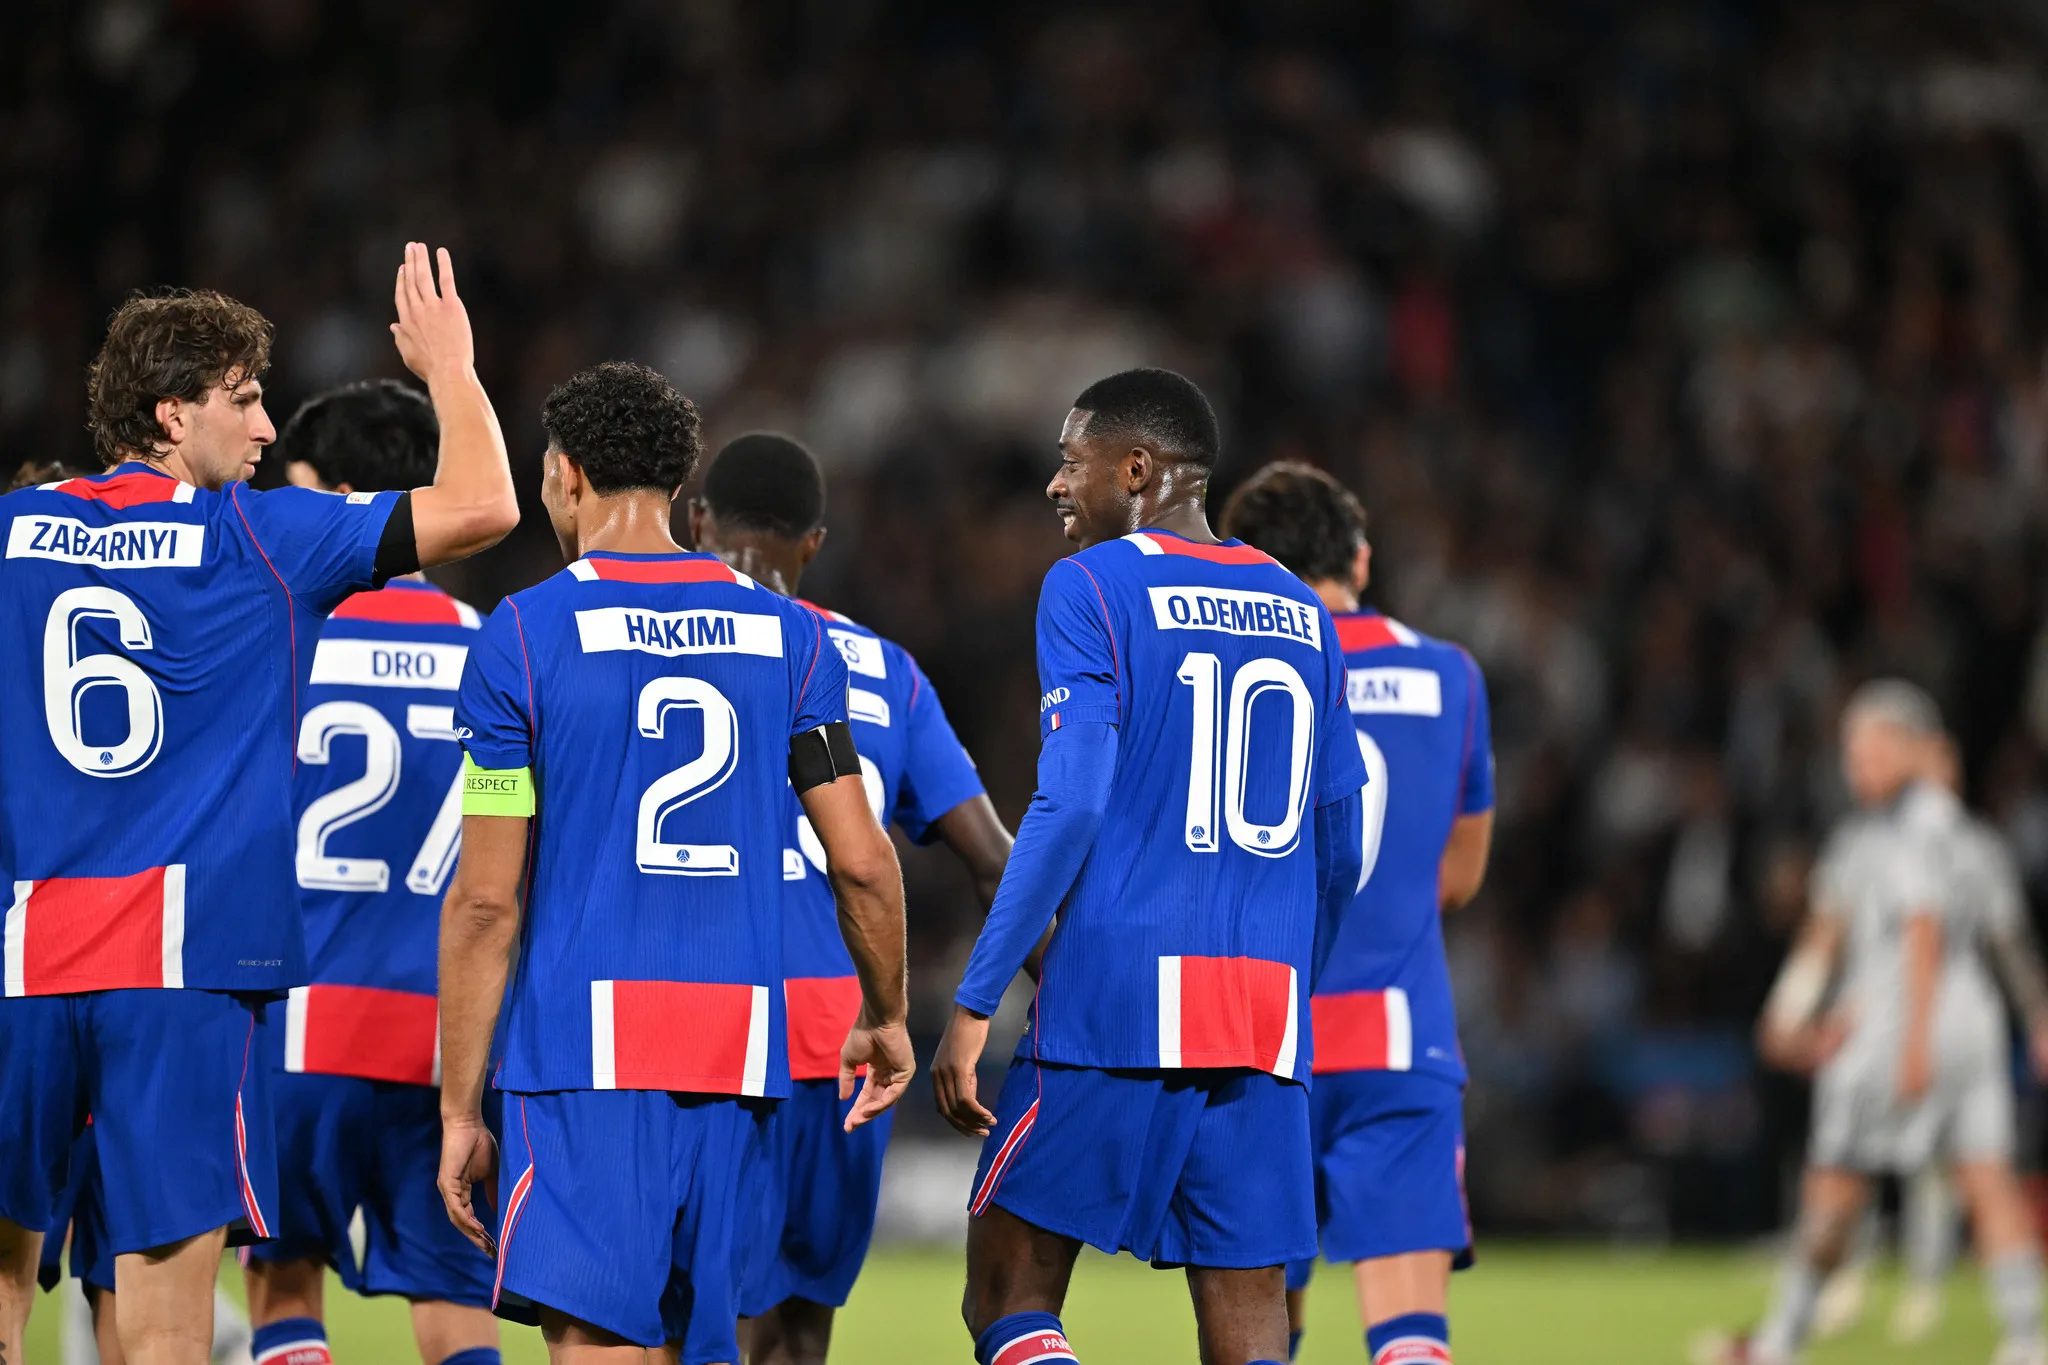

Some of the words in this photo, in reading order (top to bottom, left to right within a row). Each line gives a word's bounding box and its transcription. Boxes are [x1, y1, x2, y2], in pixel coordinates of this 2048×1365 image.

[30, 521, 178, 562] ZABARNYI
[44, 586, 164, 779] 6
[372, 650, 436, 679] DRO
[625, 613, 736, 650] HAKIMI
[295, 700, 465, 896] 27
[466, 778, 519, 792] RESPECT
[636, 676, 739, 878] 2
[1176, 652, 1316, 859] 10
